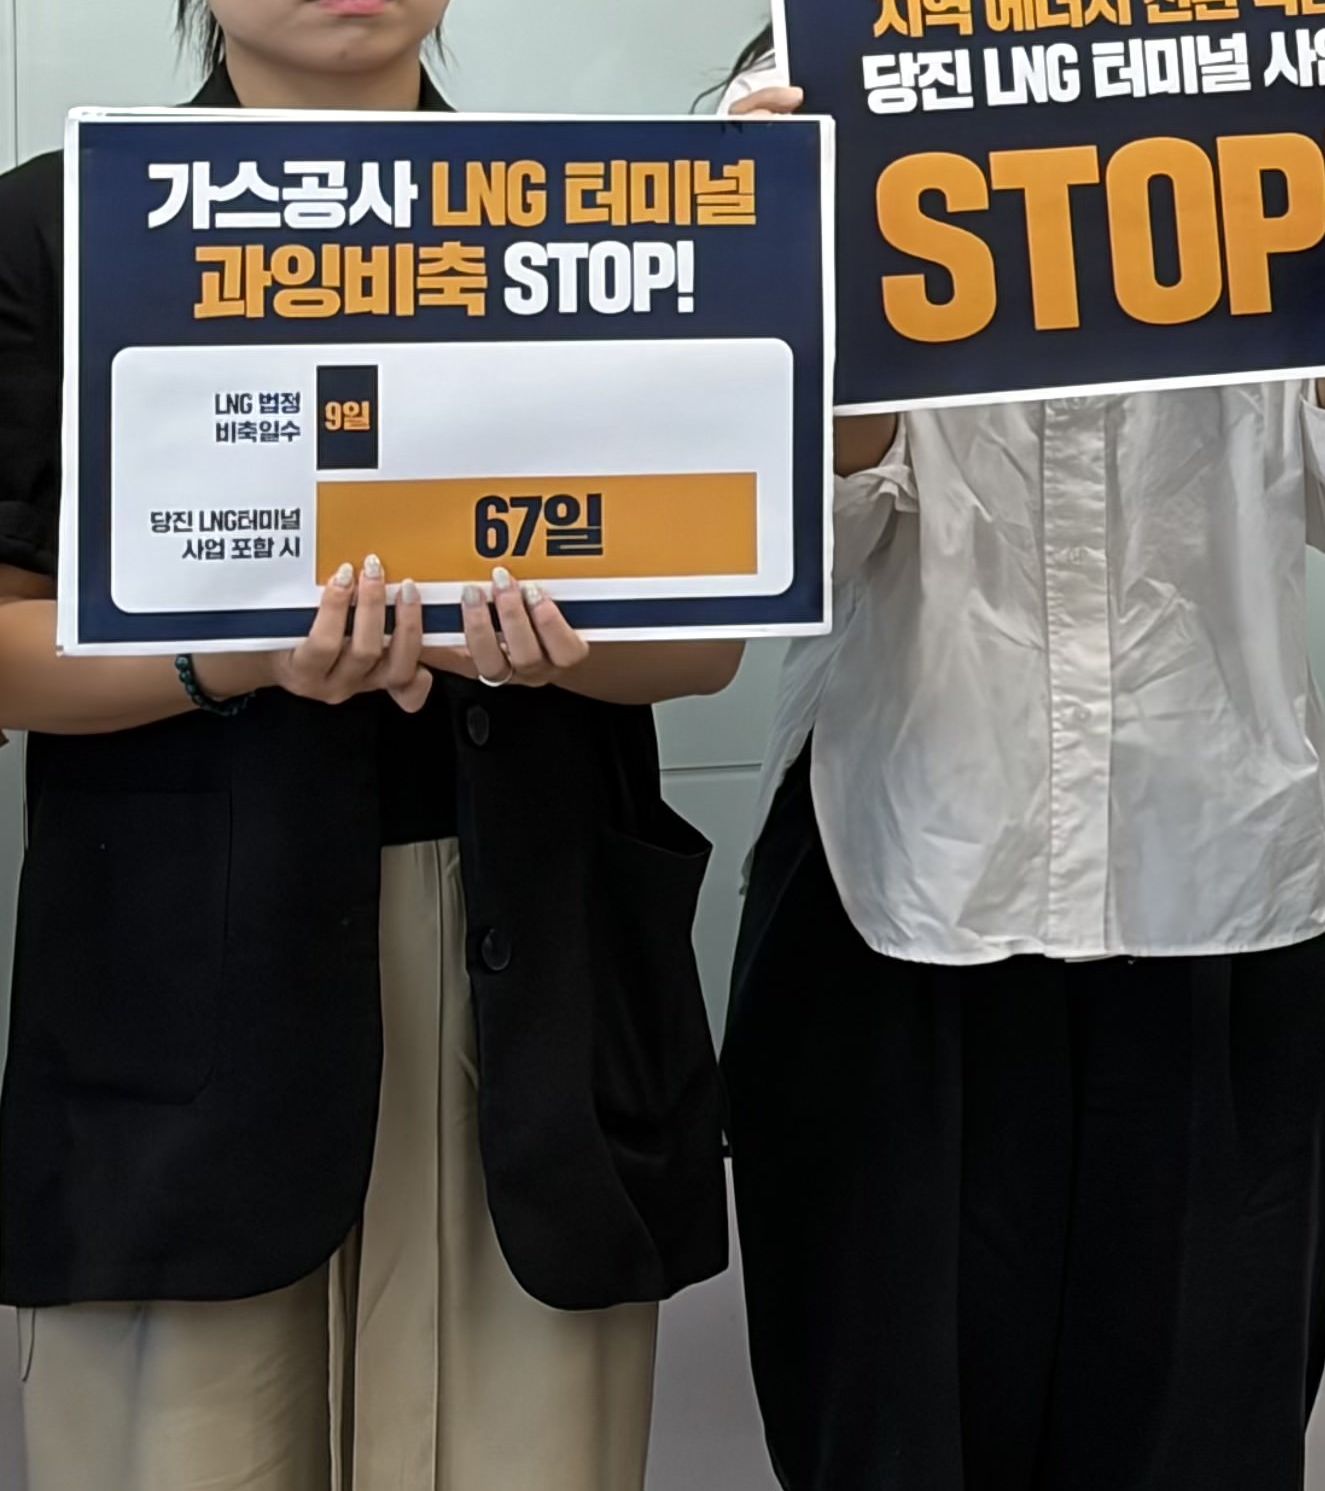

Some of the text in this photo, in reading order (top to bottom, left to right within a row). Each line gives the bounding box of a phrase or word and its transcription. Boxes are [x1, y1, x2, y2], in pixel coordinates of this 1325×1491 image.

[862, 49, 975, 114] 당진
[983, 42, 1081, 107] LNG
[1092, 32, 1251, 98] 터미널
[146, 158, 757, 230] 가스공사 LNG 터미널
[193, 239, 695, 318] 과잉비축 STOP!
[214, 391, 301, 415] LNG 법정
[324, 400, 371, 431] 9일
[215, 420, 301, 443] 비축일수
[150, 508, 301, 533] 당진 LNG터미널
[474, 494, 604, 558] 67일
[182, 537, 300, 560] 사업 포함 시
